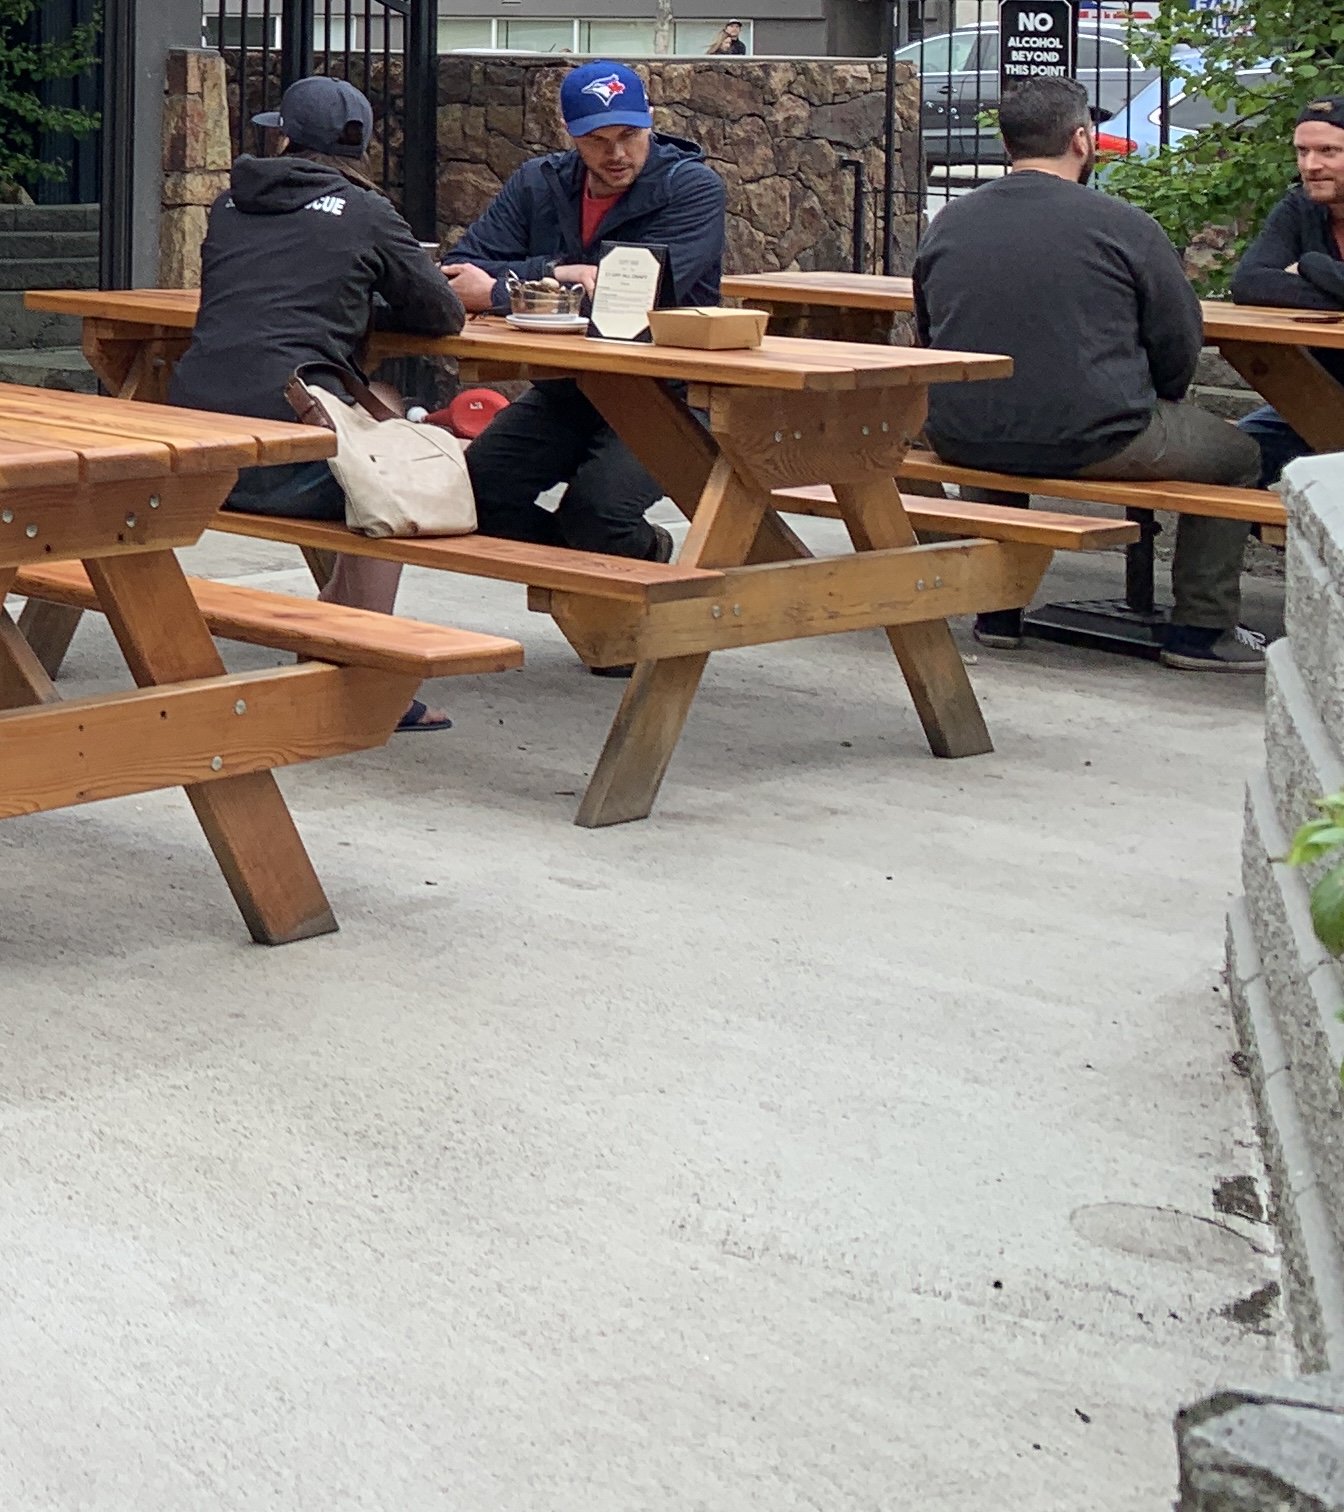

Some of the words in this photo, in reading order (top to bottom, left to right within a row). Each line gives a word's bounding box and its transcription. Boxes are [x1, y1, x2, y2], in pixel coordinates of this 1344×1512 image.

[1017, 11, 1053, 32] NO
[1007, 36, 1064, 49] ALCOHOL
[1011, 50, 1060, 63] BEYOND
[1004, 64, 1029, 76] THIS
[1030, 65, 1066, 77] POINT
